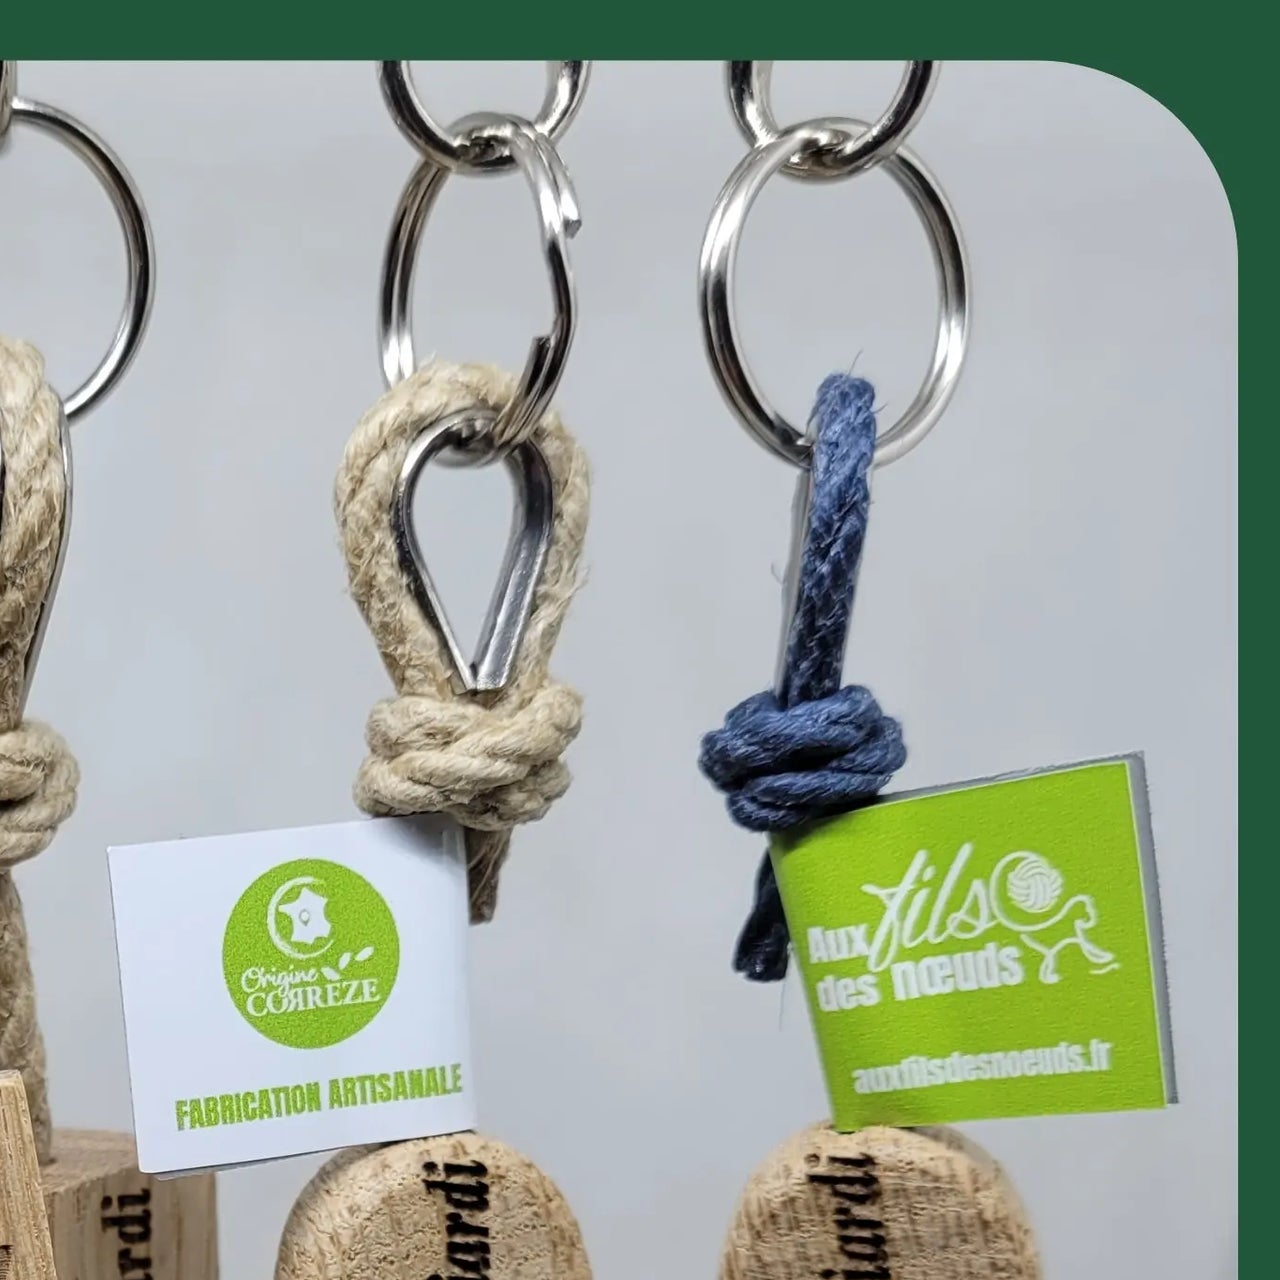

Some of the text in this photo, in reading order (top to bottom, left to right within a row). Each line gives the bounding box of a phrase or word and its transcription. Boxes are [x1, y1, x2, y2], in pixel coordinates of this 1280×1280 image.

[807, 842, 998, 972] Aux fils
[241, 964, 318, 997] Origine
[816, 975, 882, 1012] des
[852, 1039, 1113, 1094] auxfilsdesnoeuds.fr
[175, 1063, 463, 1131] FABRICATION ARTISANALE
